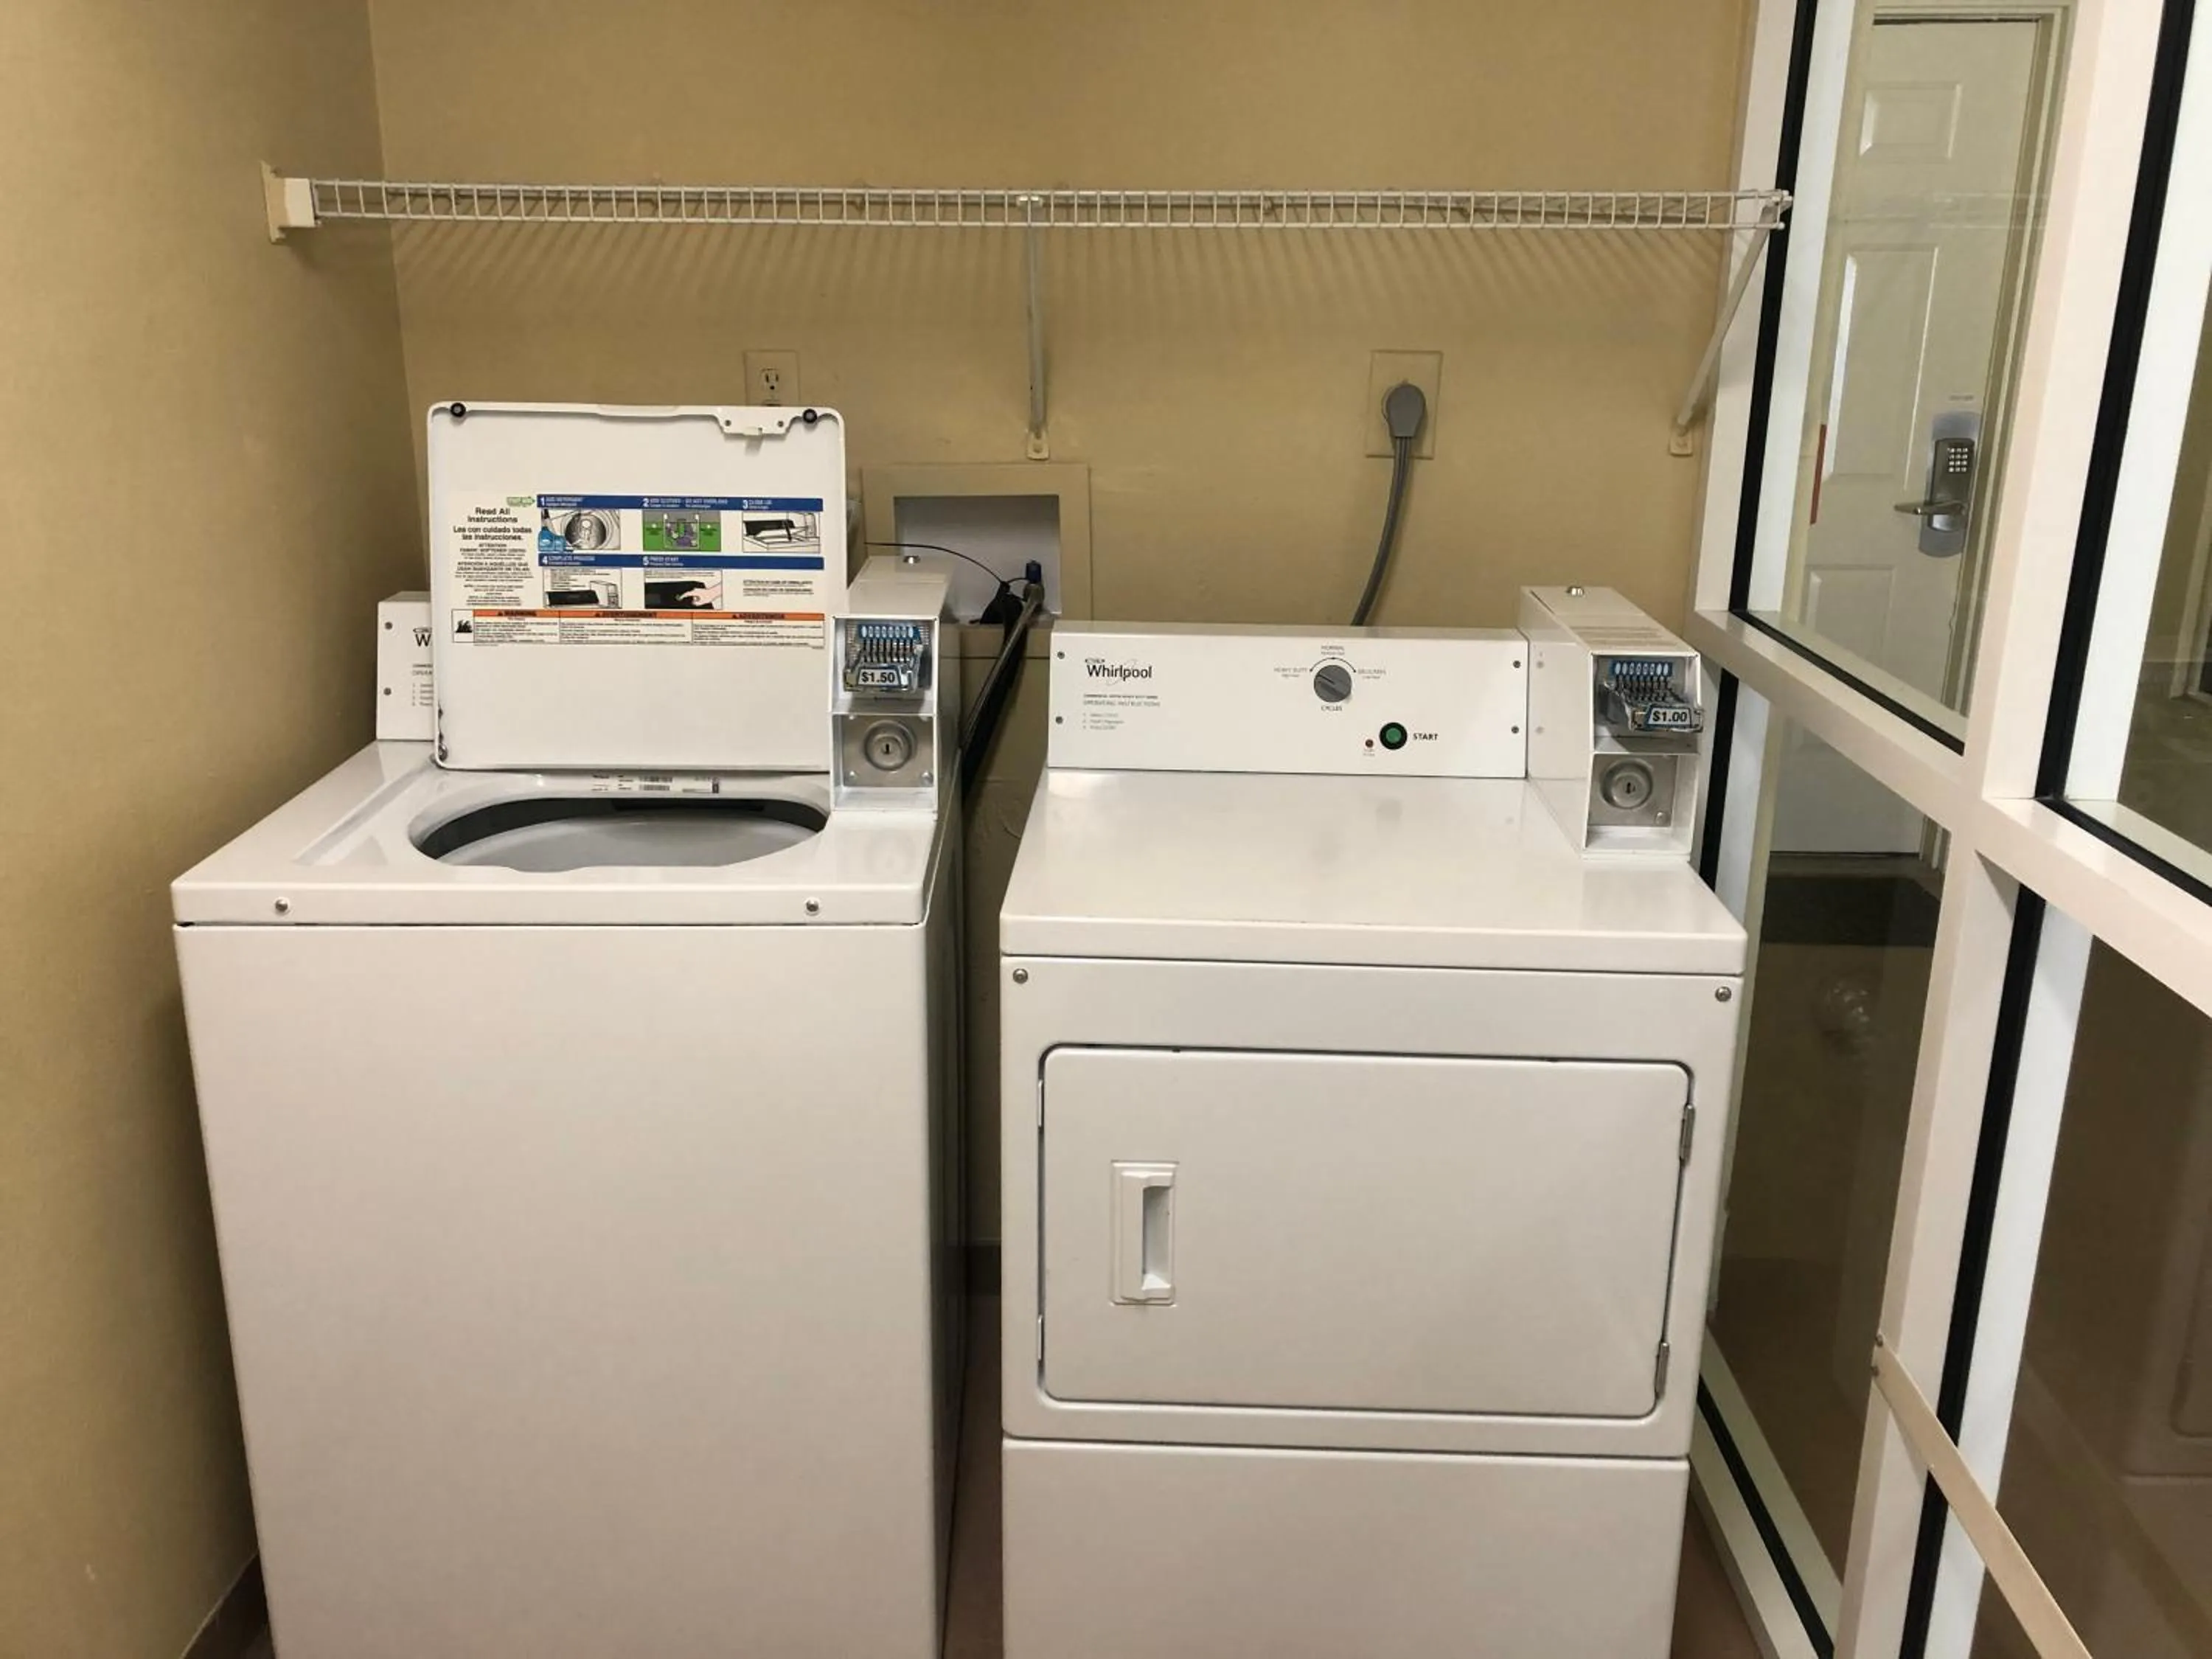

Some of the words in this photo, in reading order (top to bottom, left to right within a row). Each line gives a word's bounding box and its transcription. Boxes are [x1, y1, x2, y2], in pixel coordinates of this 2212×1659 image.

[643, 498, 649, 508] 2
[742, 499, 748, 509] 3
[475, 507, 497, 515] Read
[498, 507, 510, 515] All
[542, 554, 548, 565] 4
[643, 555, 650, 566] 5
[861, 671, 896, 683] $1.50
[1086, 664, 1152, 681] Whirlpool
[1652, 710, 1688, 722] $1.00
[1413, 733, 1439, 741] START
